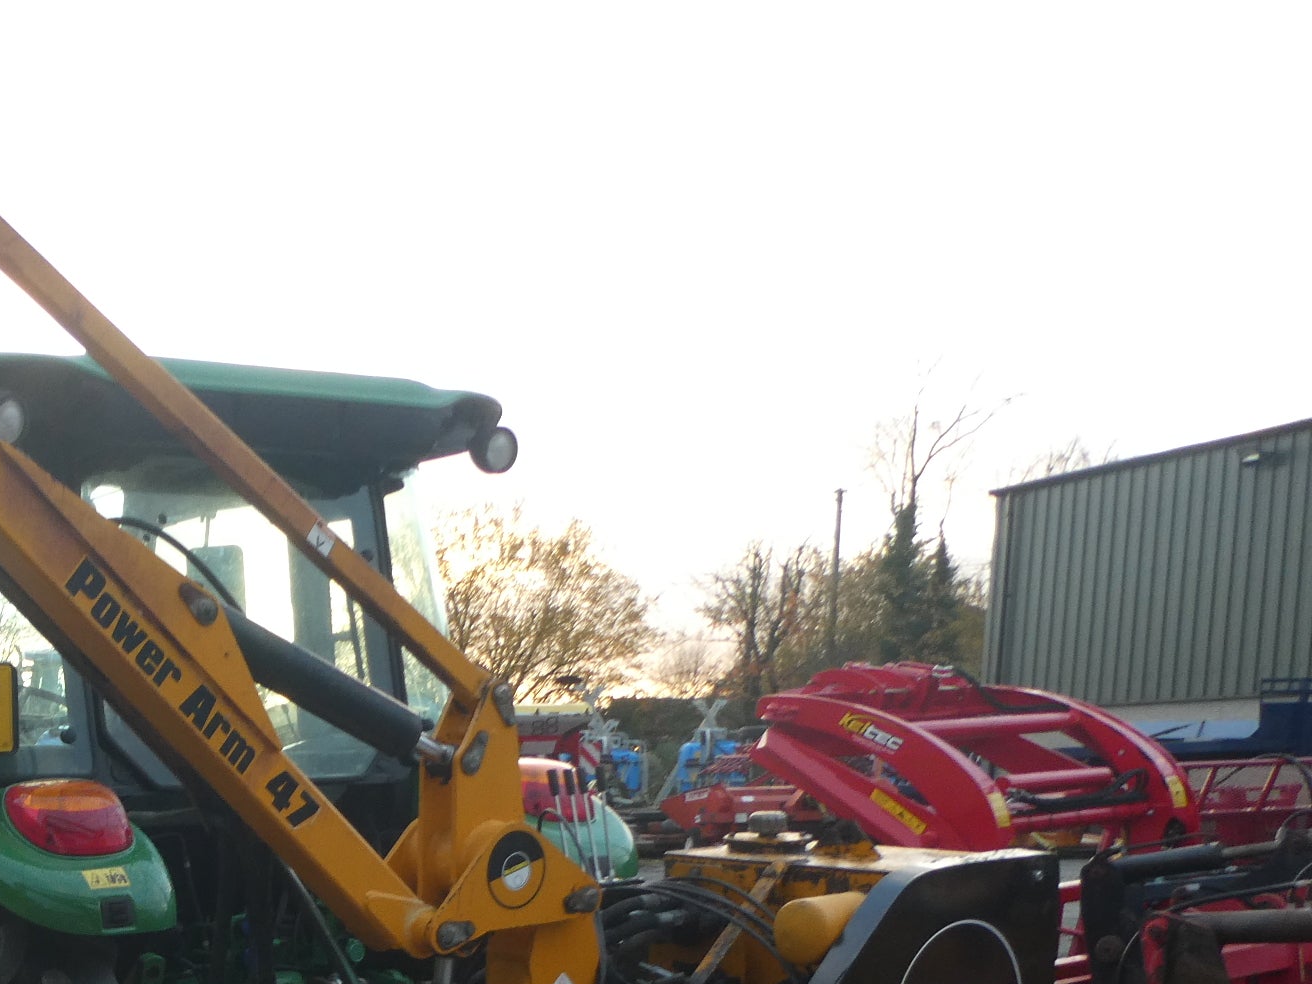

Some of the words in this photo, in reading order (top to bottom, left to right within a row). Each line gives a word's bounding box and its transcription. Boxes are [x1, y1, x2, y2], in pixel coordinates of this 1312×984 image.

[65, 558, 182, 688] Power
[179, 684, 256, 775] Arm
[265, 771, 321, 828] 47
